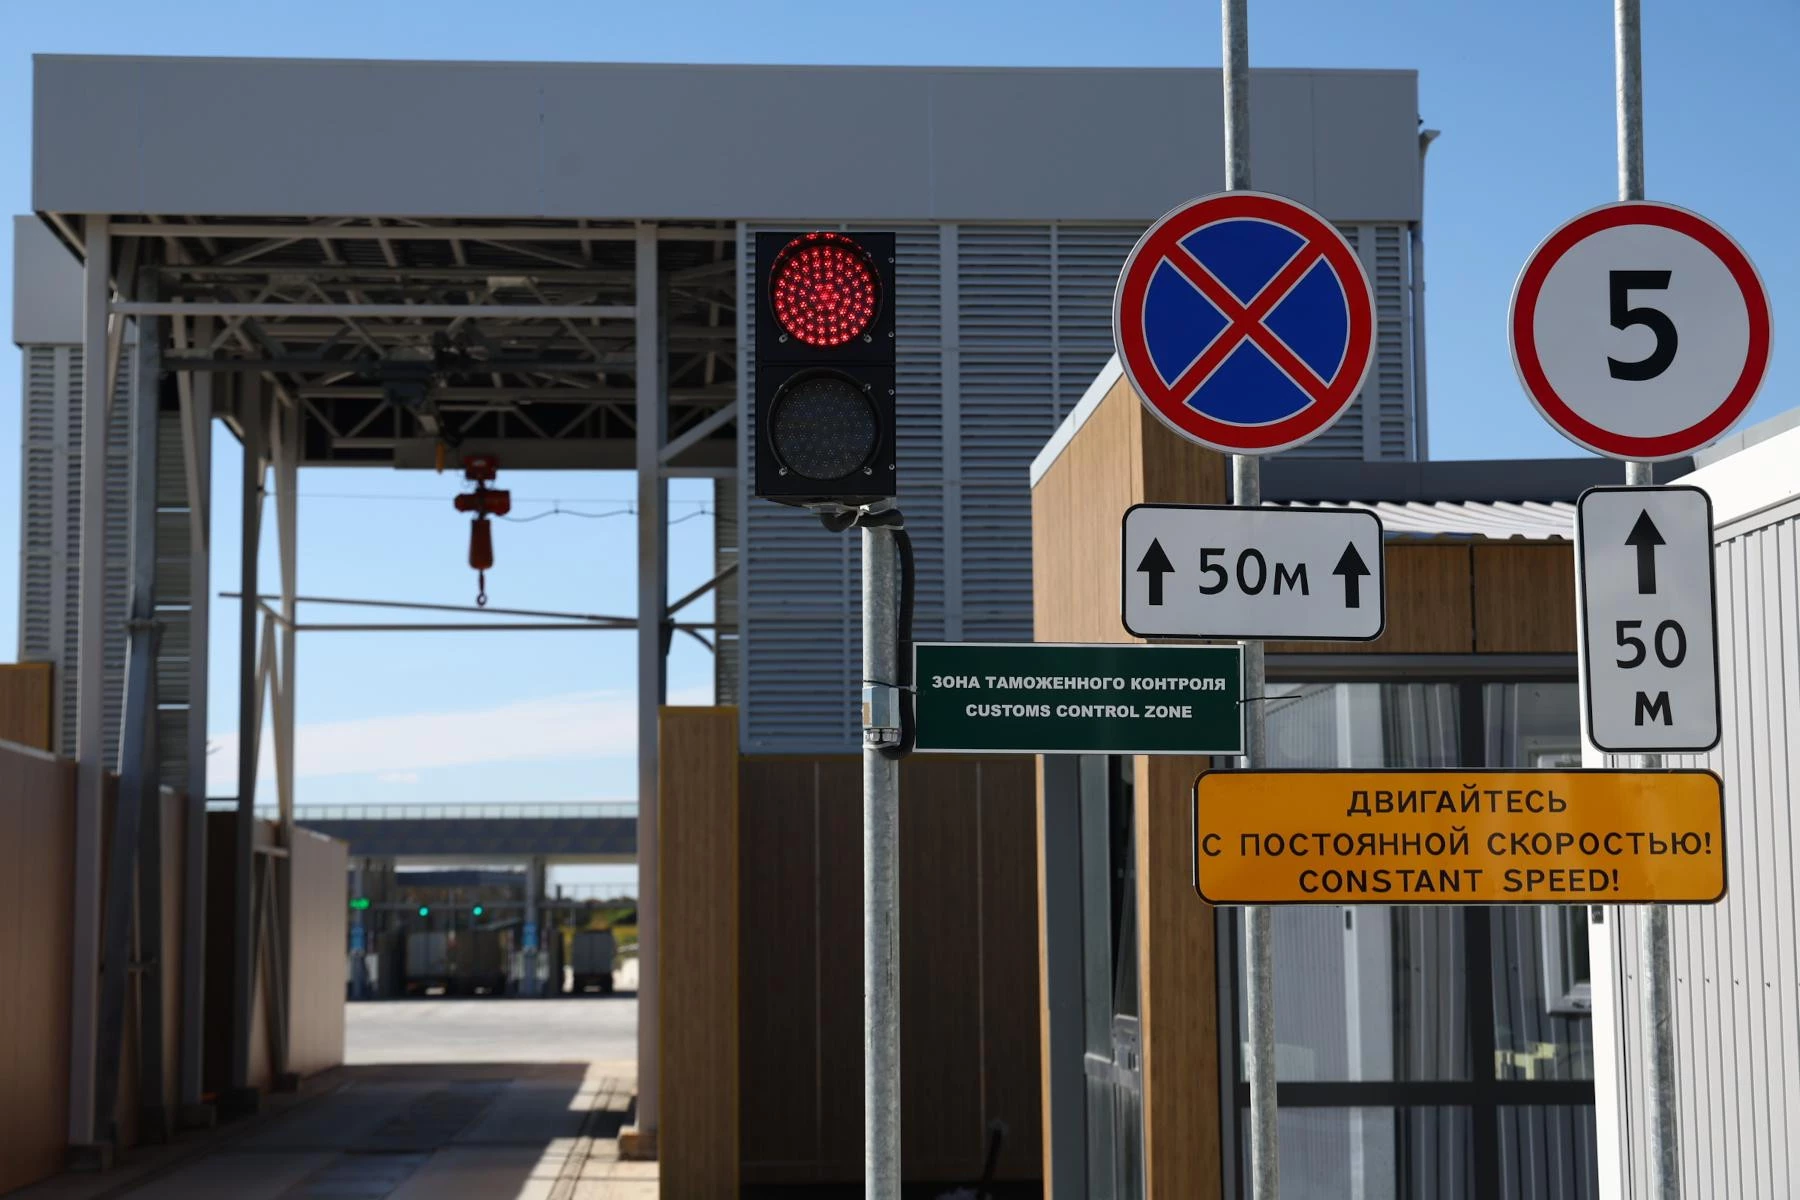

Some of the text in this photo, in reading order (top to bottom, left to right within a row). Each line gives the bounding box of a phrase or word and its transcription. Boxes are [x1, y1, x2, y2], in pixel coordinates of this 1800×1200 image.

[1607, 270, 1679, 382] 5
[1615, 619, 1687, 670] 50
[931, 675, 1226, 691] ЗОНА ТАМОЖЕННОГО КОНТРОЛЯ
[965, 703, 1193, 719] CUSTOMS CONTROL ZONE
[1346, 783, 1567, 818] ДВИГАЙТЕСЬ
[1202, 825, 1712, 857] С ПОСТОЯННОЙ СКОРОСТЬЮ!
[1298, 868, 1620, 894] CONSTANT SPEED!
